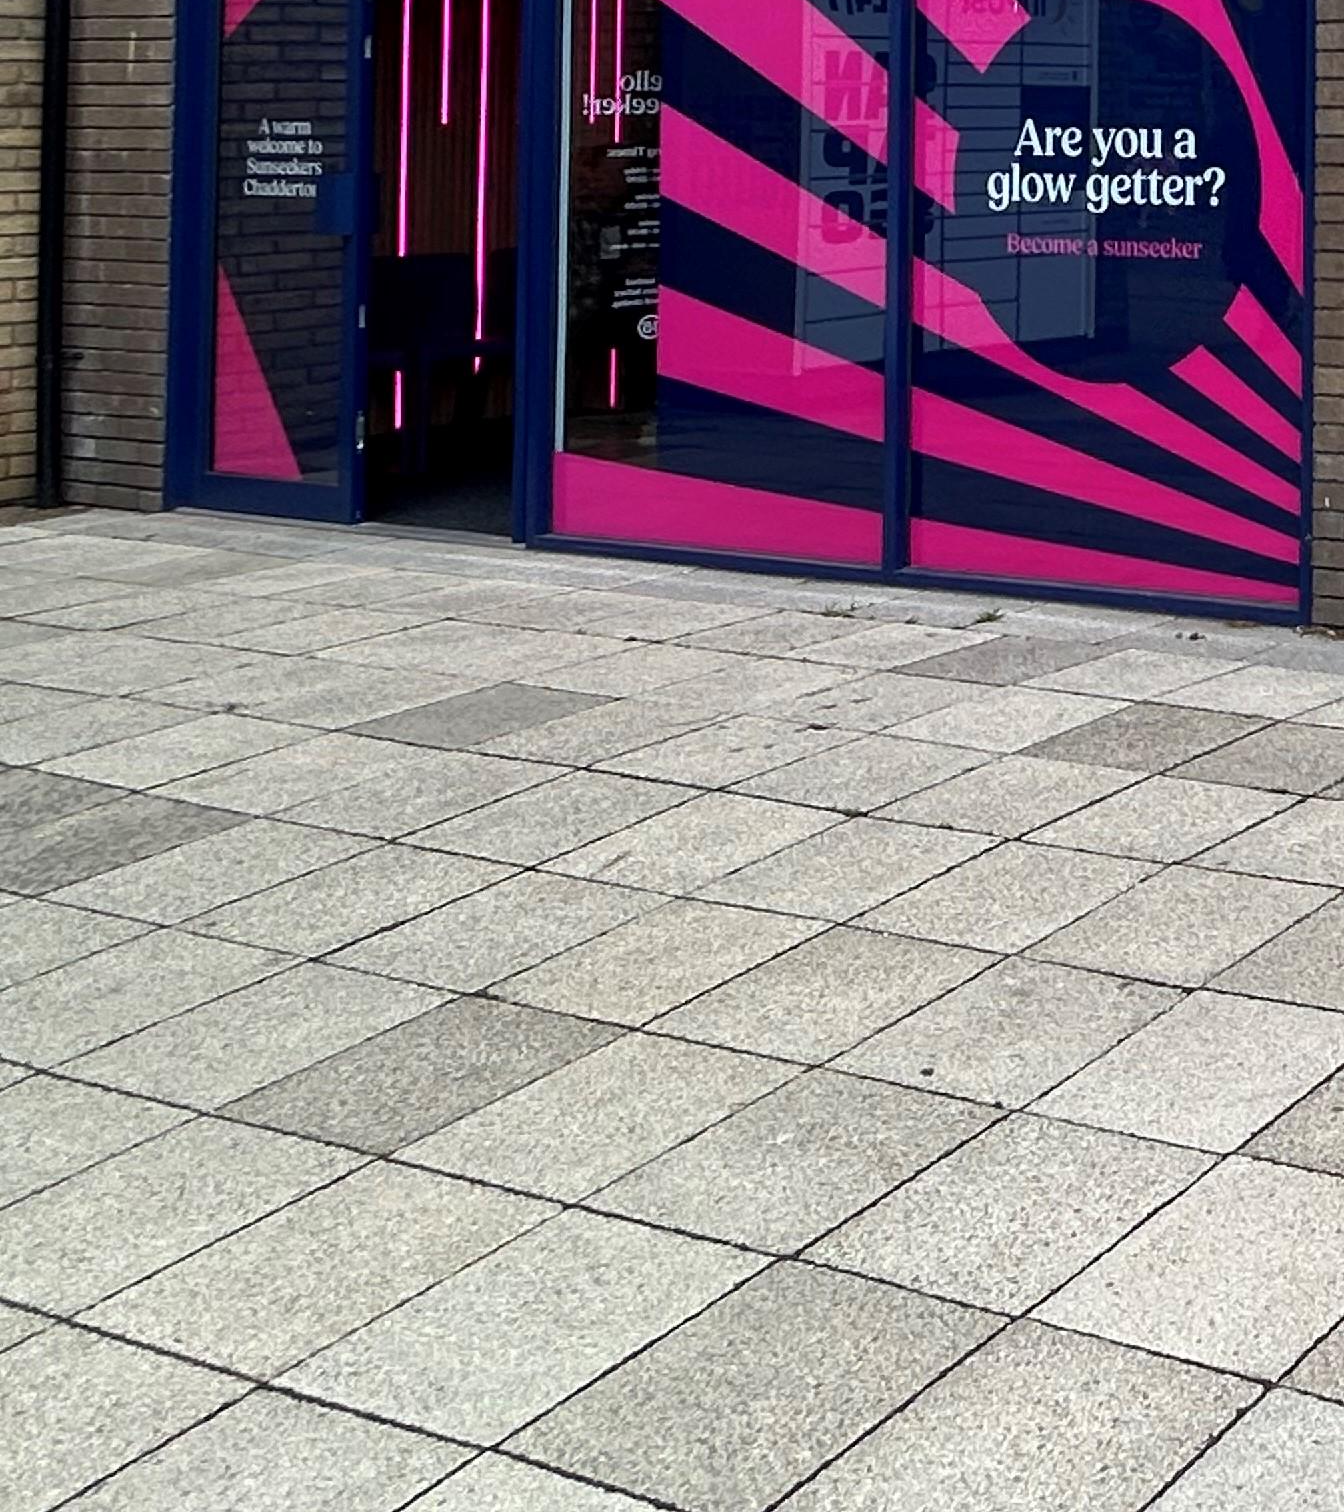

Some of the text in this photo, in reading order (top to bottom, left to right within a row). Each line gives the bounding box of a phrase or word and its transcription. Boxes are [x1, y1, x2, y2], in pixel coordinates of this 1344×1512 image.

[259, 117, 270, 135] A
[246, 136, 323, 154] welcome to
[1014, 118, 1198, 168] Are you a
[986, 162, 1227, 215] glow getter?
[1007, 232, 1202, 259] Become a sunseeker
